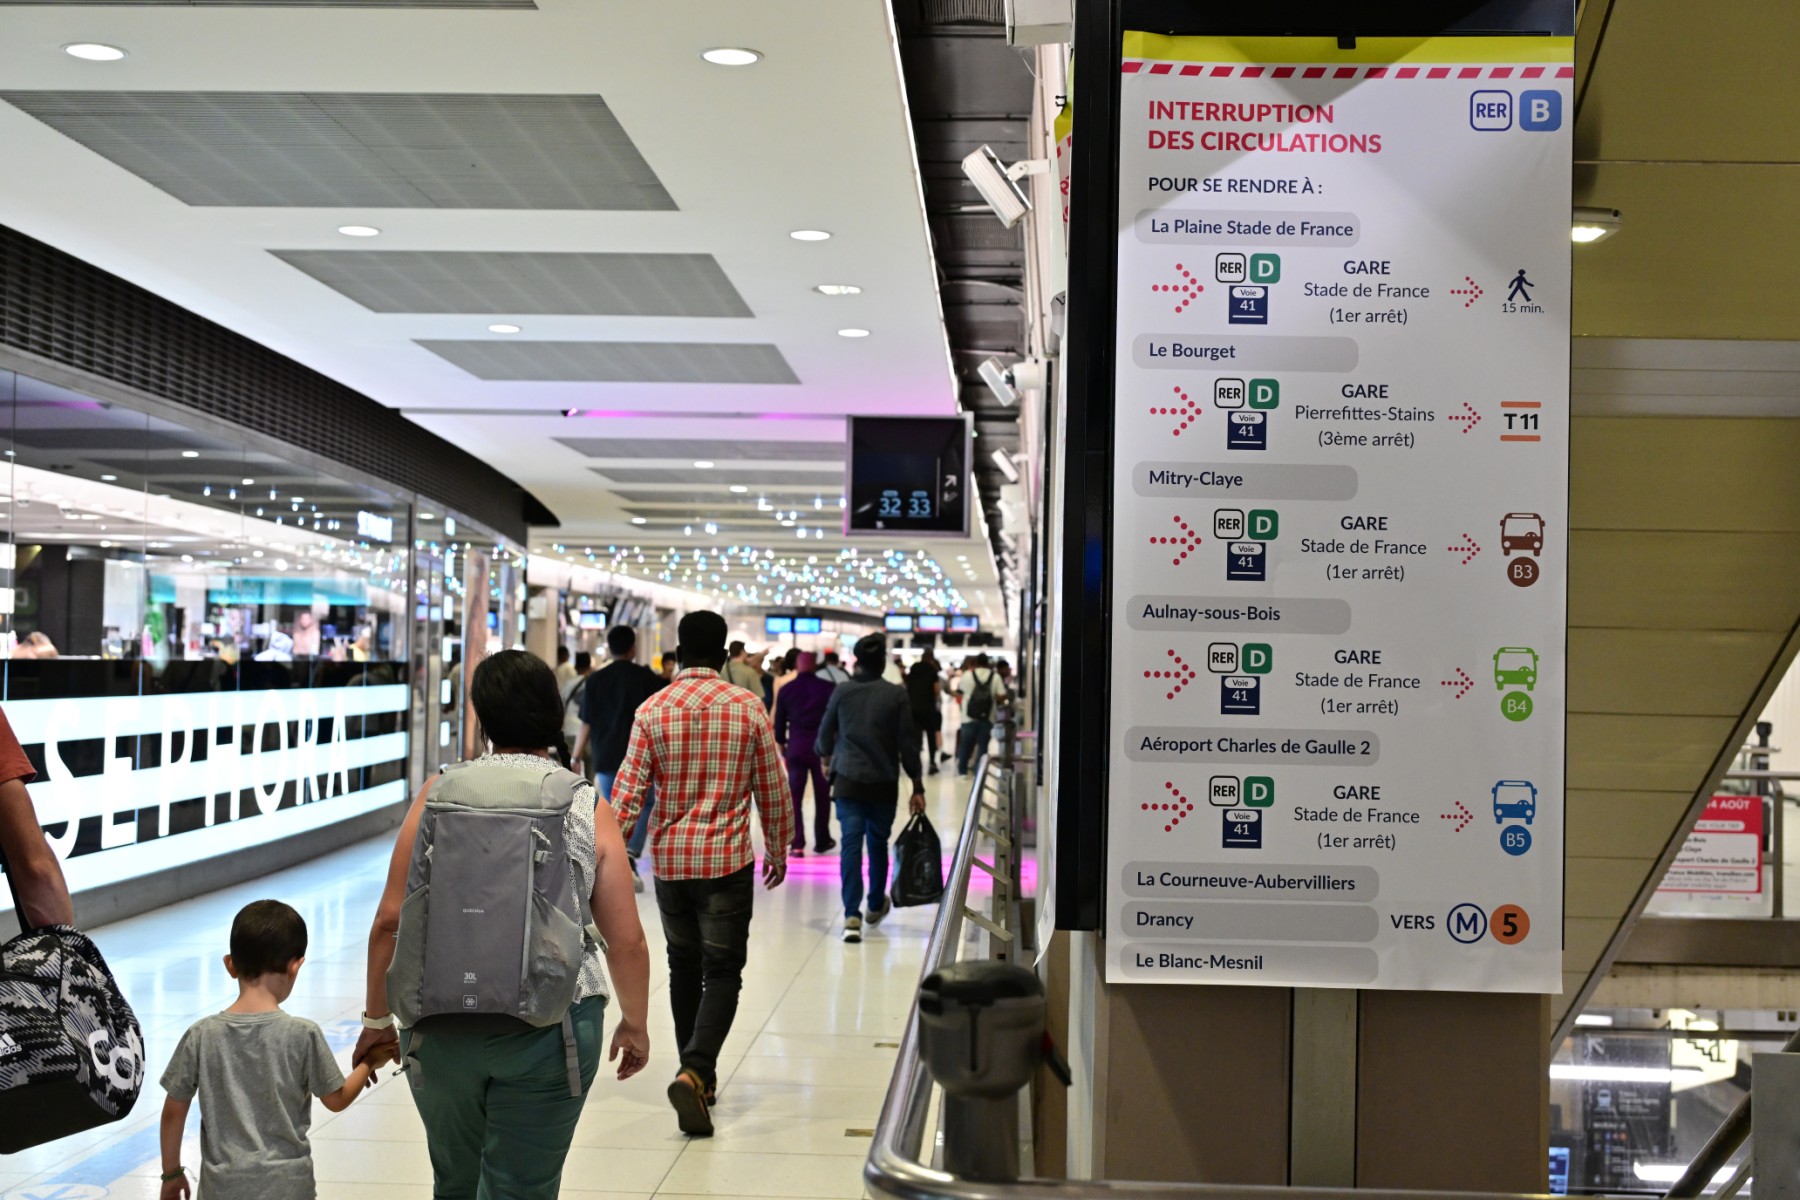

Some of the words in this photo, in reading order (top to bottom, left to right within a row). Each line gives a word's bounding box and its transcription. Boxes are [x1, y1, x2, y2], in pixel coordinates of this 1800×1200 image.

[1148, 100, 1334, 123] INTERRUPTION
[1476, 103, 1507, 118] RER
[1531, 99, 1550, 122] B
[1148, 131, 1195, 151] DES
[1200, 132, 1382, 154] CIRCULATIONS
[1148, 177, 1198, 192] POUR
[1203, 179, 1222, 193] SE
[1227, 179, 1298, 194] RENDRE
[1151, 218, 1169, 233] La
[1174, 219, 1223, 235] Plaine
[1226, 220, 1272, 236] Stade
[1275, 221, 1296, 236] de
[1300, 222, 1354, 237] France
[1219, 261, 1243, 274] RER
[1257, 260, 1274, 277] D
[1343, 261, 1391, 275] GARE
[1240, 289, 1257, 297] Voie
[1304, 283, 1347, 297] Stade
[1353, 283, 1372, 297] de
[1377, 284, 1430, 298] France
[1239, 299, 1256, 312] 41
[1502, 302, 1516, 313] 15
[1520, 302, 1545, 313] min.
[1329, 308, 1361, 325] (1er
[1366, 309, 1408, 326] arrêt)
[1149, 343, 1168, 357] Le
[1172, 343, 1236, 362] Bourget
[1218, 387, 1241, 399] RER
[1256, 385, 1272, 402] D
[1341, 384, 1389, 399] GARE
[1239, 414, 1256, 422] Voie
[1295, 404, 1435, 422] Pierrefittes-Stains
[1238, 425, 1254, 437] 41
[1318, 431, 1367, 448] (3ème
[1372, 432, 1415, 449] arrêt)
[1149, 470, 1243, 488] Mitry-Claye
[879, 497, 902, 514] 32
[908, 498, 931, 514] 33
[1217, 517, 1241, 530] RER
[1255, 516, 1272, 533] D
[1340, 516, 1388, 531] GARE
[1238, 545, 1254, 553] Voie
[1301, 539, 1344, 554] Stade
[1349, 540, 1369, 554] de
[1374, 540, 1427, 555] France
[1238, 556, 1254, 568] 41
[1326, 564, 1358, 581] (1er
[1362, 565, 1405, 583] arrêt)
[1513, 564, 1533, 579] B3
[1142, 603, 1281, 622] Aulnay-sous-Bois
[1211, 651, 1235, 664] RER
[1250, 650, 1266, 667] D
[1334, 650, 1382, 665] GARE
[1232, 679, 1249, 687] Voie
[1295, 672, 1338, 687] Stade
[1344, 673, 1363, 688] de
[1369, 674, 1421, 689] France
[1231, 690, 1248, 702] 41
[1320, 698, 1352, 715] (1er
[1357, 699, 1399, 717] arrêt)
[1507, 698, 1527, 713] B4
[1140, 737, 1213, 755] Aéroport
[1217, 738, 1277, 754] Charles
[1281, 739, 1301, 754] de
[1305, 740, 1356, 755] Gaulle
[1360, 741, 1371, 756] 2
[44, 690, 349, 861] SEPHORA
[1213, 785, 1236, 797] RER
[1251, 783, 1268, 800] D
[1333, 786, 1381, 801] GARE
[1719, 797, 1751, 810] AOÛT
[1234, 812, 1251, 820] Voie
[1294, 807, 1338, 822] Stade
[1343, 808, 1363, 823] de
[1368, 808, 1420, 824] France
[1233, 823, 1250, 835] 41
[1317, 833, 1349, 850] (1er
[1353, 834, 1396, 852] arrêt)
[1506, 832, 1525, 847] B5
[1137, 872, 1155, 886] La
[1159, 872, 1356, 891] Courneuve-Aubervilliers
[1136, 912, 1194, 930] Drancy
[1391, 914, 1435, 930] VERS
[1502, 912, 1518, 937] 5
[1136, 953, 1154, 968] Le
[1159, 954, 1263, 970] Blanc-Mesnil
[464, 972, 477, 981] 30L
[0, 1043, 23, 1057] idas
